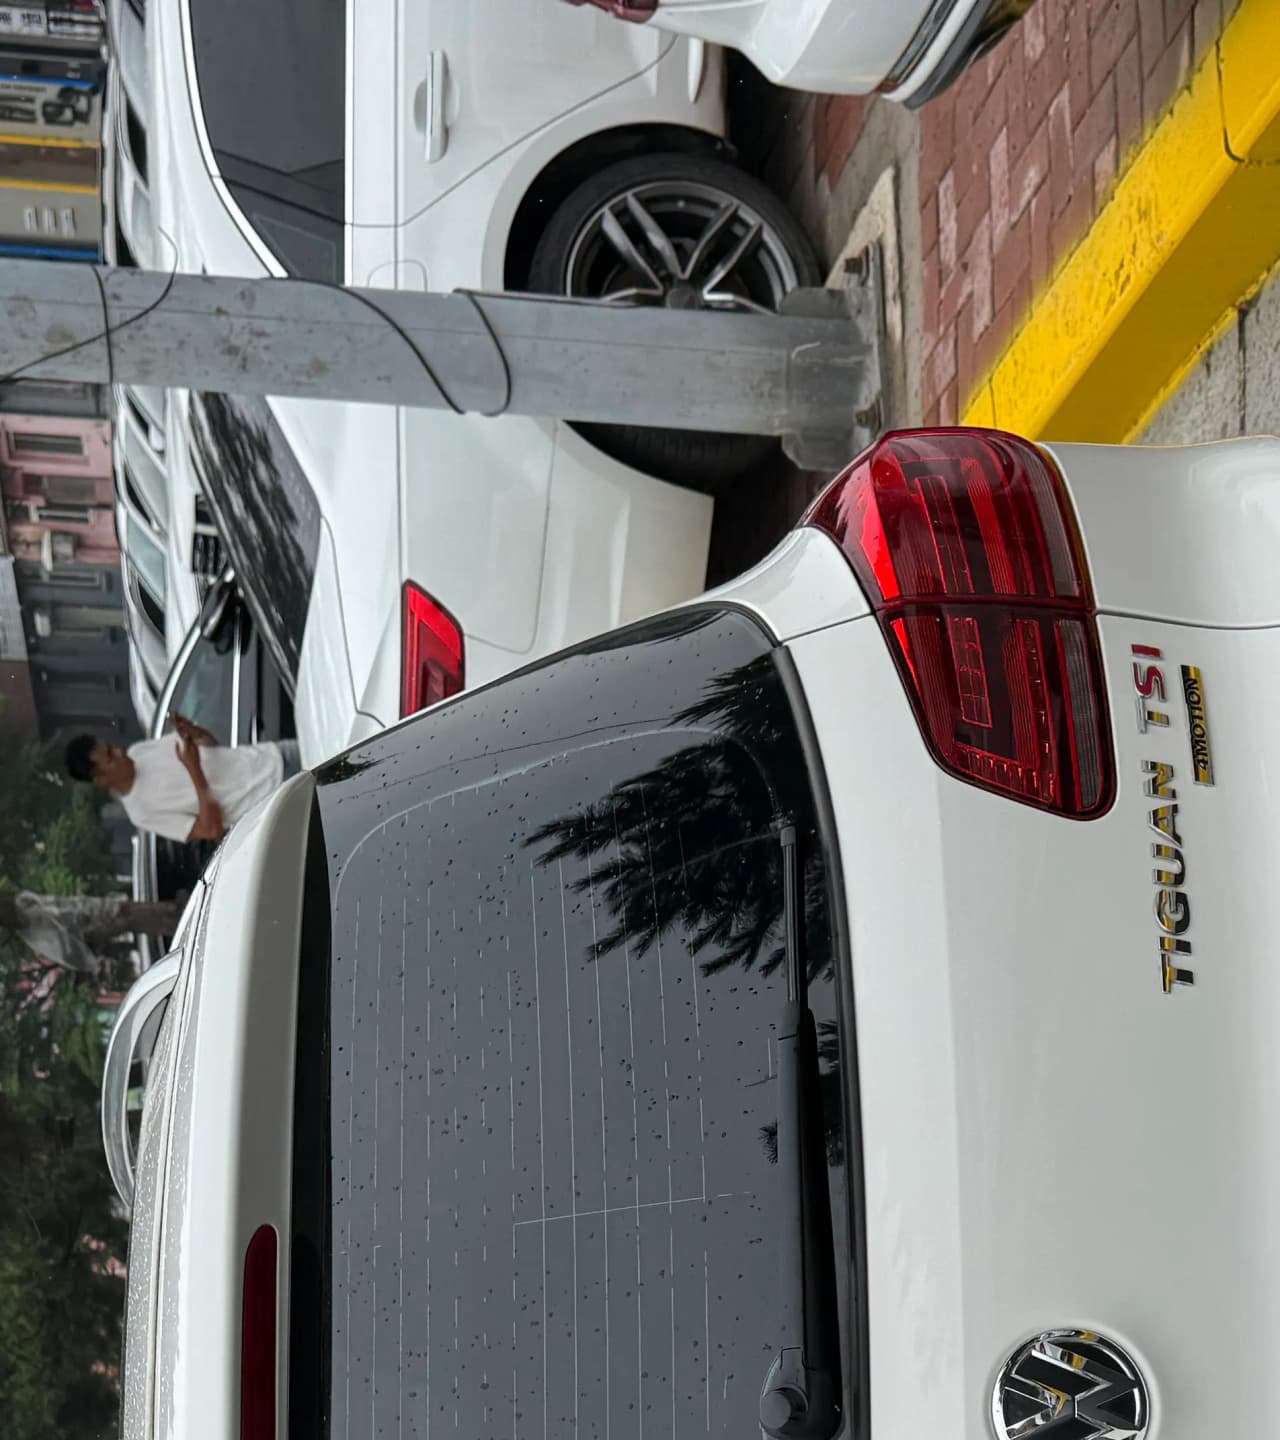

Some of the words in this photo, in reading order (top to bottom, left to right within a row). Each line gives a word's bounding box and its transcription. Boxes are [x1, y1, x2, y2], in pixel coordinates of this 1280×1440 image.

[1130, 643, 1170, 734] TSI
[1184, 674, 1211, 773] 4MOTION
[1140, 759, 1194, 995] TIGUAN
